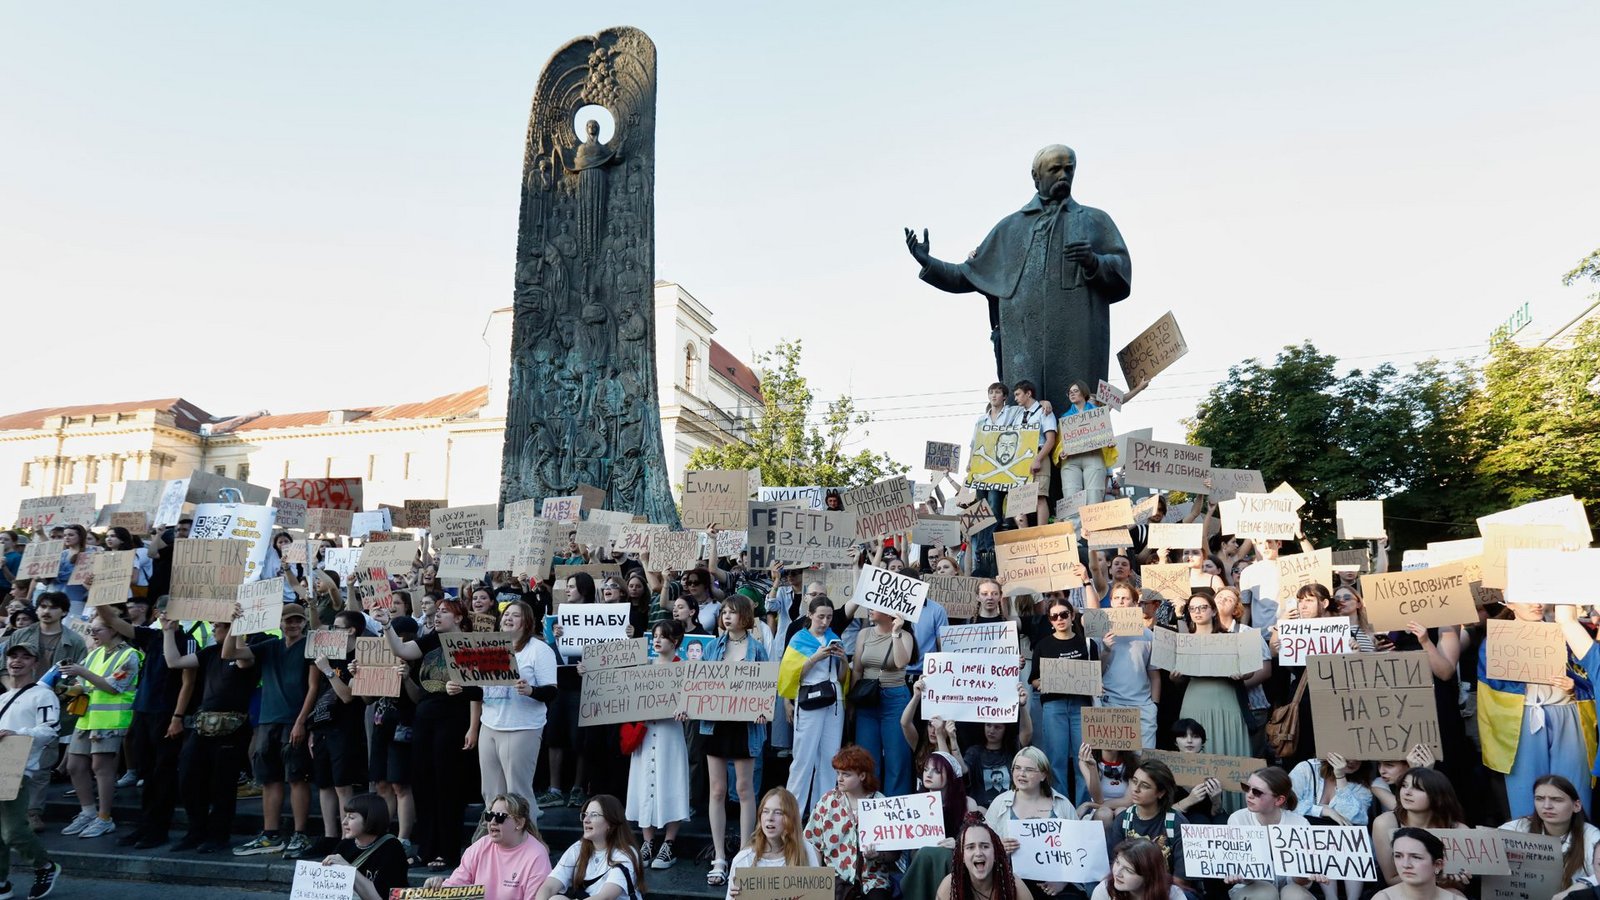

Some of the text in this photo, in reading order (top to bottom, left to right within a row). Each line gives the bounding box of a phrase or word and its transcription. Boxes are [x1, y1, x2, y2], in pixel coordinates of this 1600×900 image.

[890, 479, 907, 492] ЩЕ
[856, 492, 904, 516] ПОТРІБНО
[781, 511, 834, 532] ГЕТЬ
[779, 531, 822, 547] ВІД
[871, 569, 922, 597] ГОЛОС
[877, 585, 890, 596] НЕ
[1374, 574, 1464, 601] ЛІКВІДОВУЙТЕ
[865, 592, 917, 616] СТИХАТИ
[1398, 594, 1450, 616] СВОЇХ
[561, 615, 580, 626] НЕ
[561, 637, 574, 646] НЕ
[583, 639, 641, 660] ВЕРХОВНА
[1283, 635, 1344, 664] ЗРАДИ
[356, 640, 399, 664] ФРОН
[600, 652, 637, 667] ЗРАДА
[1491, 645, 1556, 660] НОМЕР
[585, 667, 673, 687] МЕНЕ ТРАХАЮТЬ
[686, 663, 730, 680] НАХУЯ
[1317, 656, 1422, 694] ЧІПАТИ
[583, 685, 604, 699] ЧАС
[634, 679, 665, 692] МНОЮ
[684, 680, 726, 693] СИСТЕМА
[1083, 714, 1137, 724] ВАШІ ГРОШІ
[1087, 725, 1137, 739] ПАХНУТЬ
[883, 809, 921, 822] ЧАСІВ
[873, 824, 945, 842] ЯНУКОВИЧА
[1020, 821, 1063, 838] ЗНОВУ
[1045, 834, 1062, 848] 16
[1207, 839, 1253, 852] ГРОШЕЙ
[1273, 826, 1368, 853] ЗАЇБАЛИ
[1035, 850, 1074, 866] СІЧНЯ
[1185, 849, 1217, 861] ЛЮДИ
[1200, 860, 1273, 878] ВІДПЛАТИ
[1279, 850, 1376, 879] РІШАЛИ
[740, 875, 833, 890] МЕНІ НЕ ОДНАКОВО
